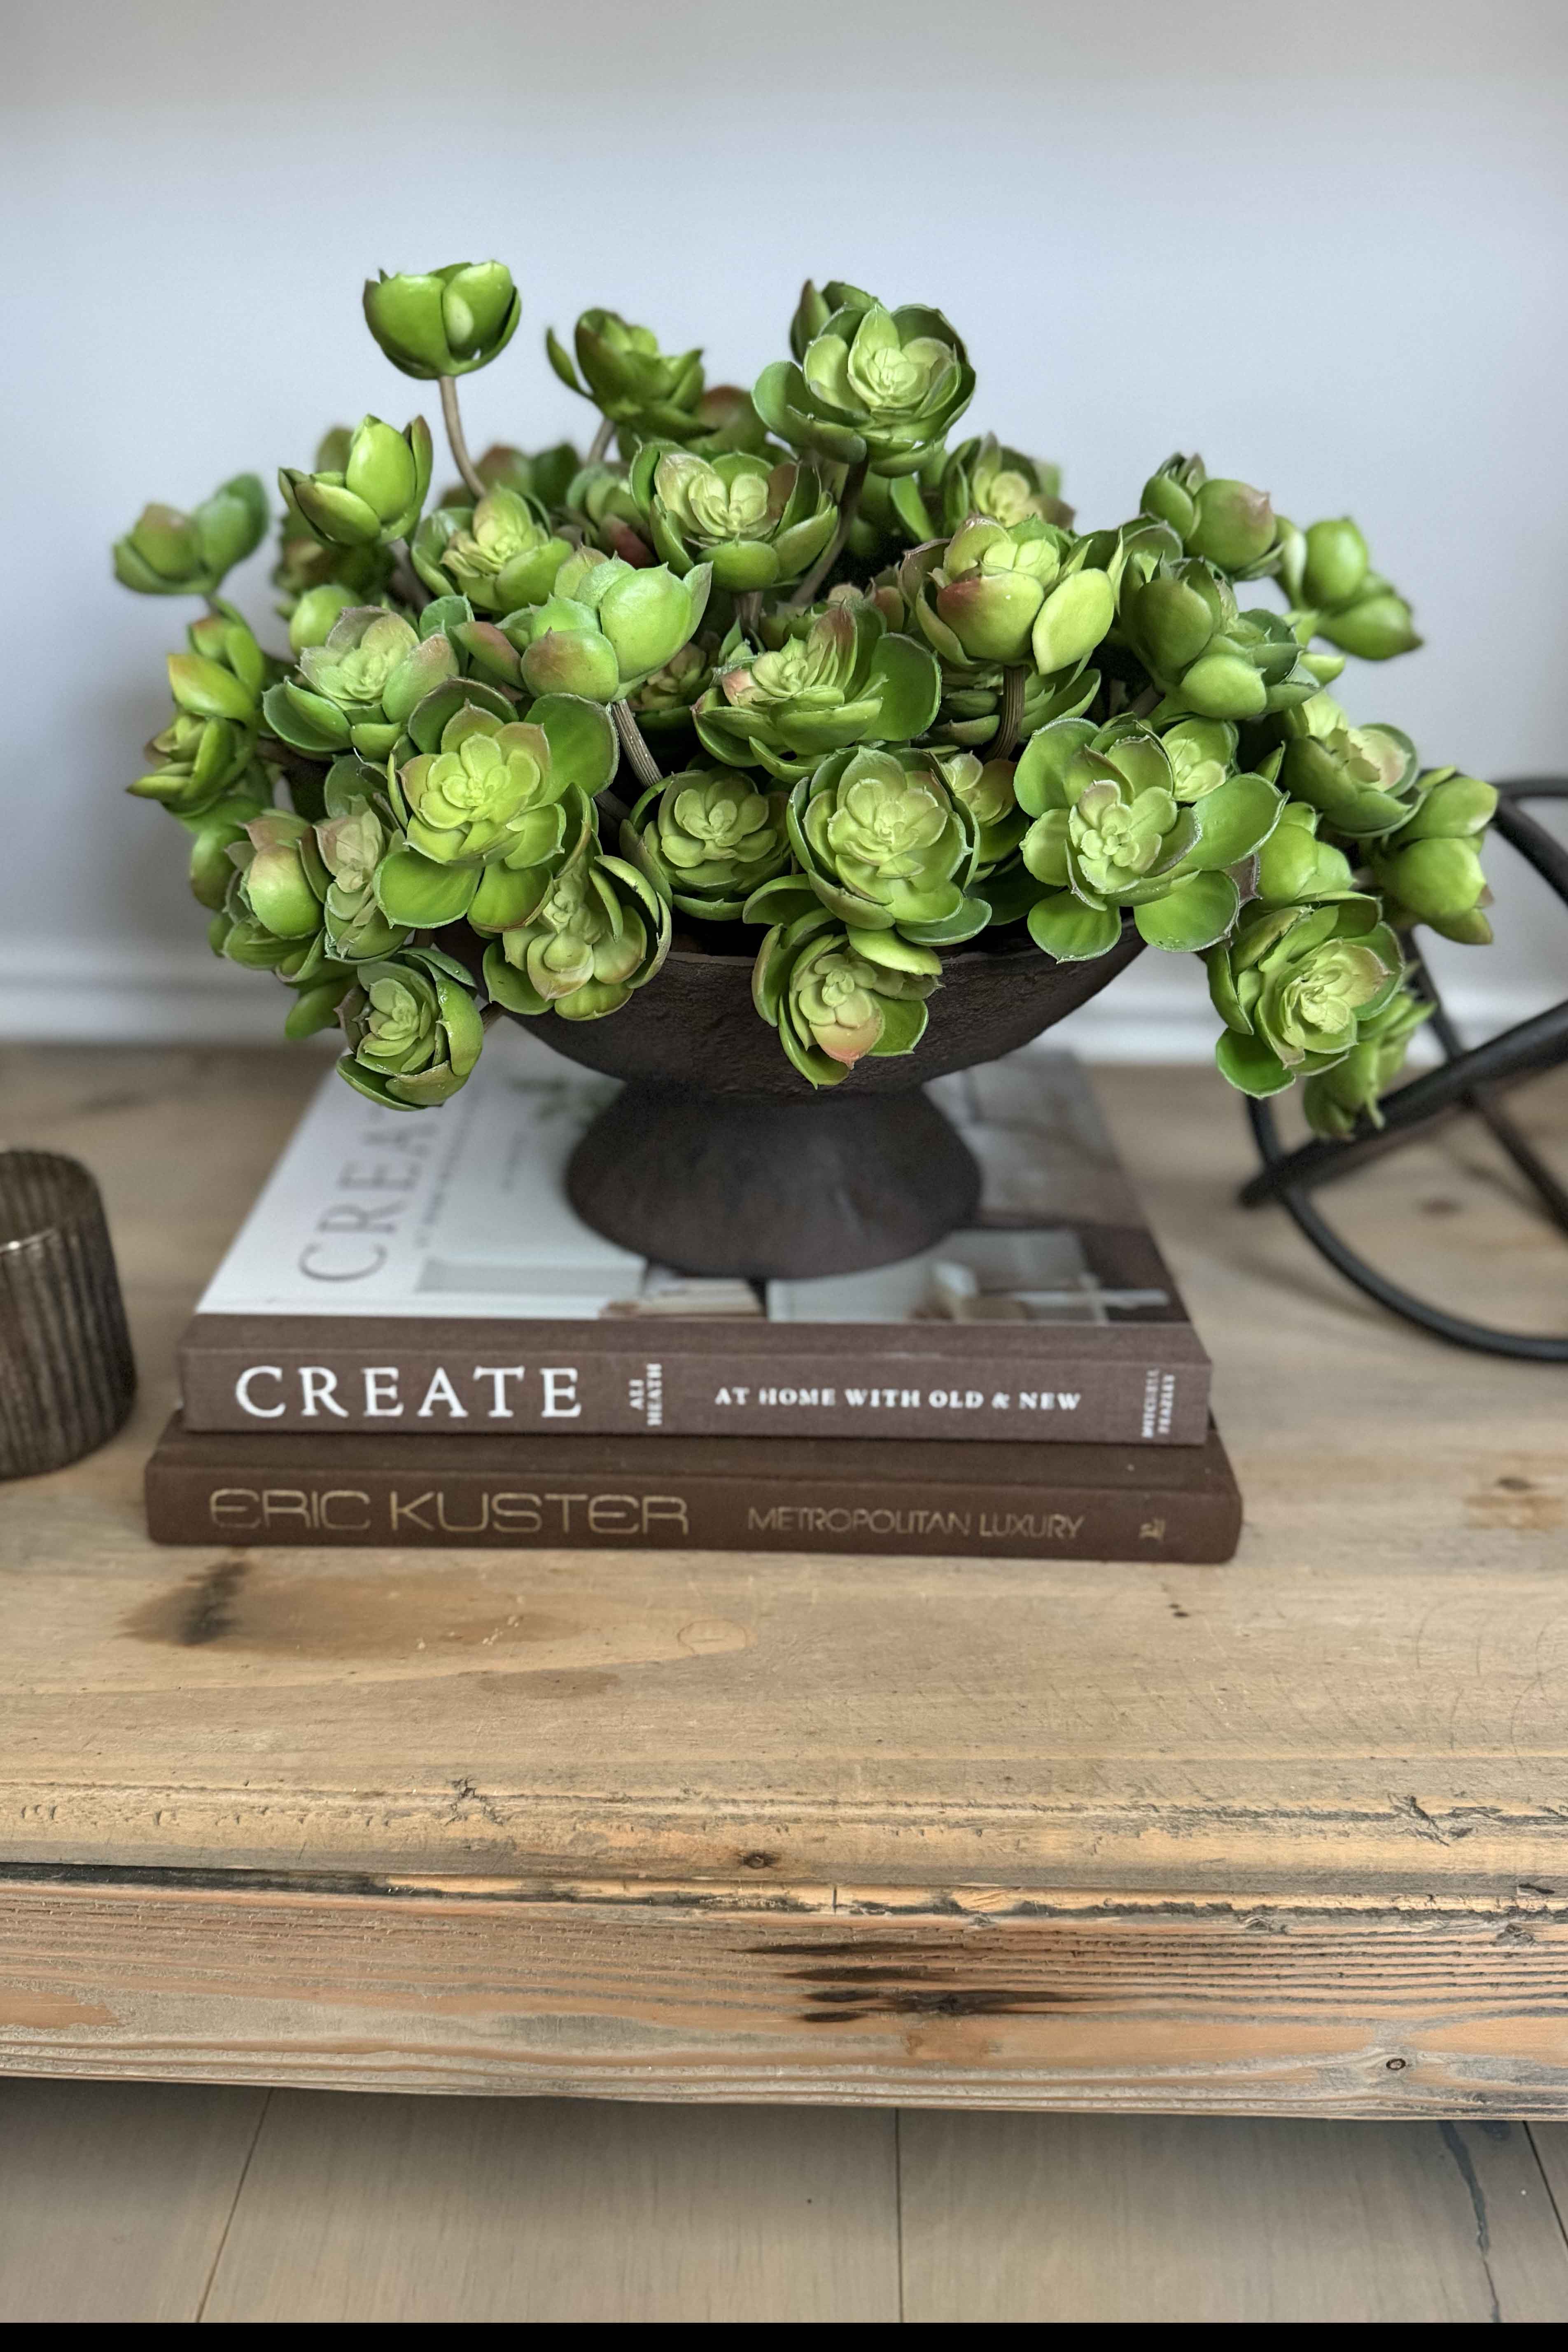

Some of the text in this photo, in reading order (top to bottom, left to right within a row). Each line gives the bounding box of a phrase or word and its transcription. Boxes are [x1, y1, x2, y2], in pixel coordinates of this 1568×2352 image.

[298, 1108, 438, 1282] CREA
[235, 1365, 582, 1418] CREATE
[629, 1379, 644, 1410] ALI
[646, 1363, 663, 1426] HEATH
[714, 1386, 750, 1406] AT
[759, 1387, 836, 1407] HOME
[844, 1388, 920, 1408] WITH
[929, 1389, 984, 1409] OLD
[1019, 1391, 1081, 1410] NEW
[210, 1488, 689, 1536] ERIC KUSTER
[747, 1506, 1086, 1540] METROPOLITAN LUXURY
